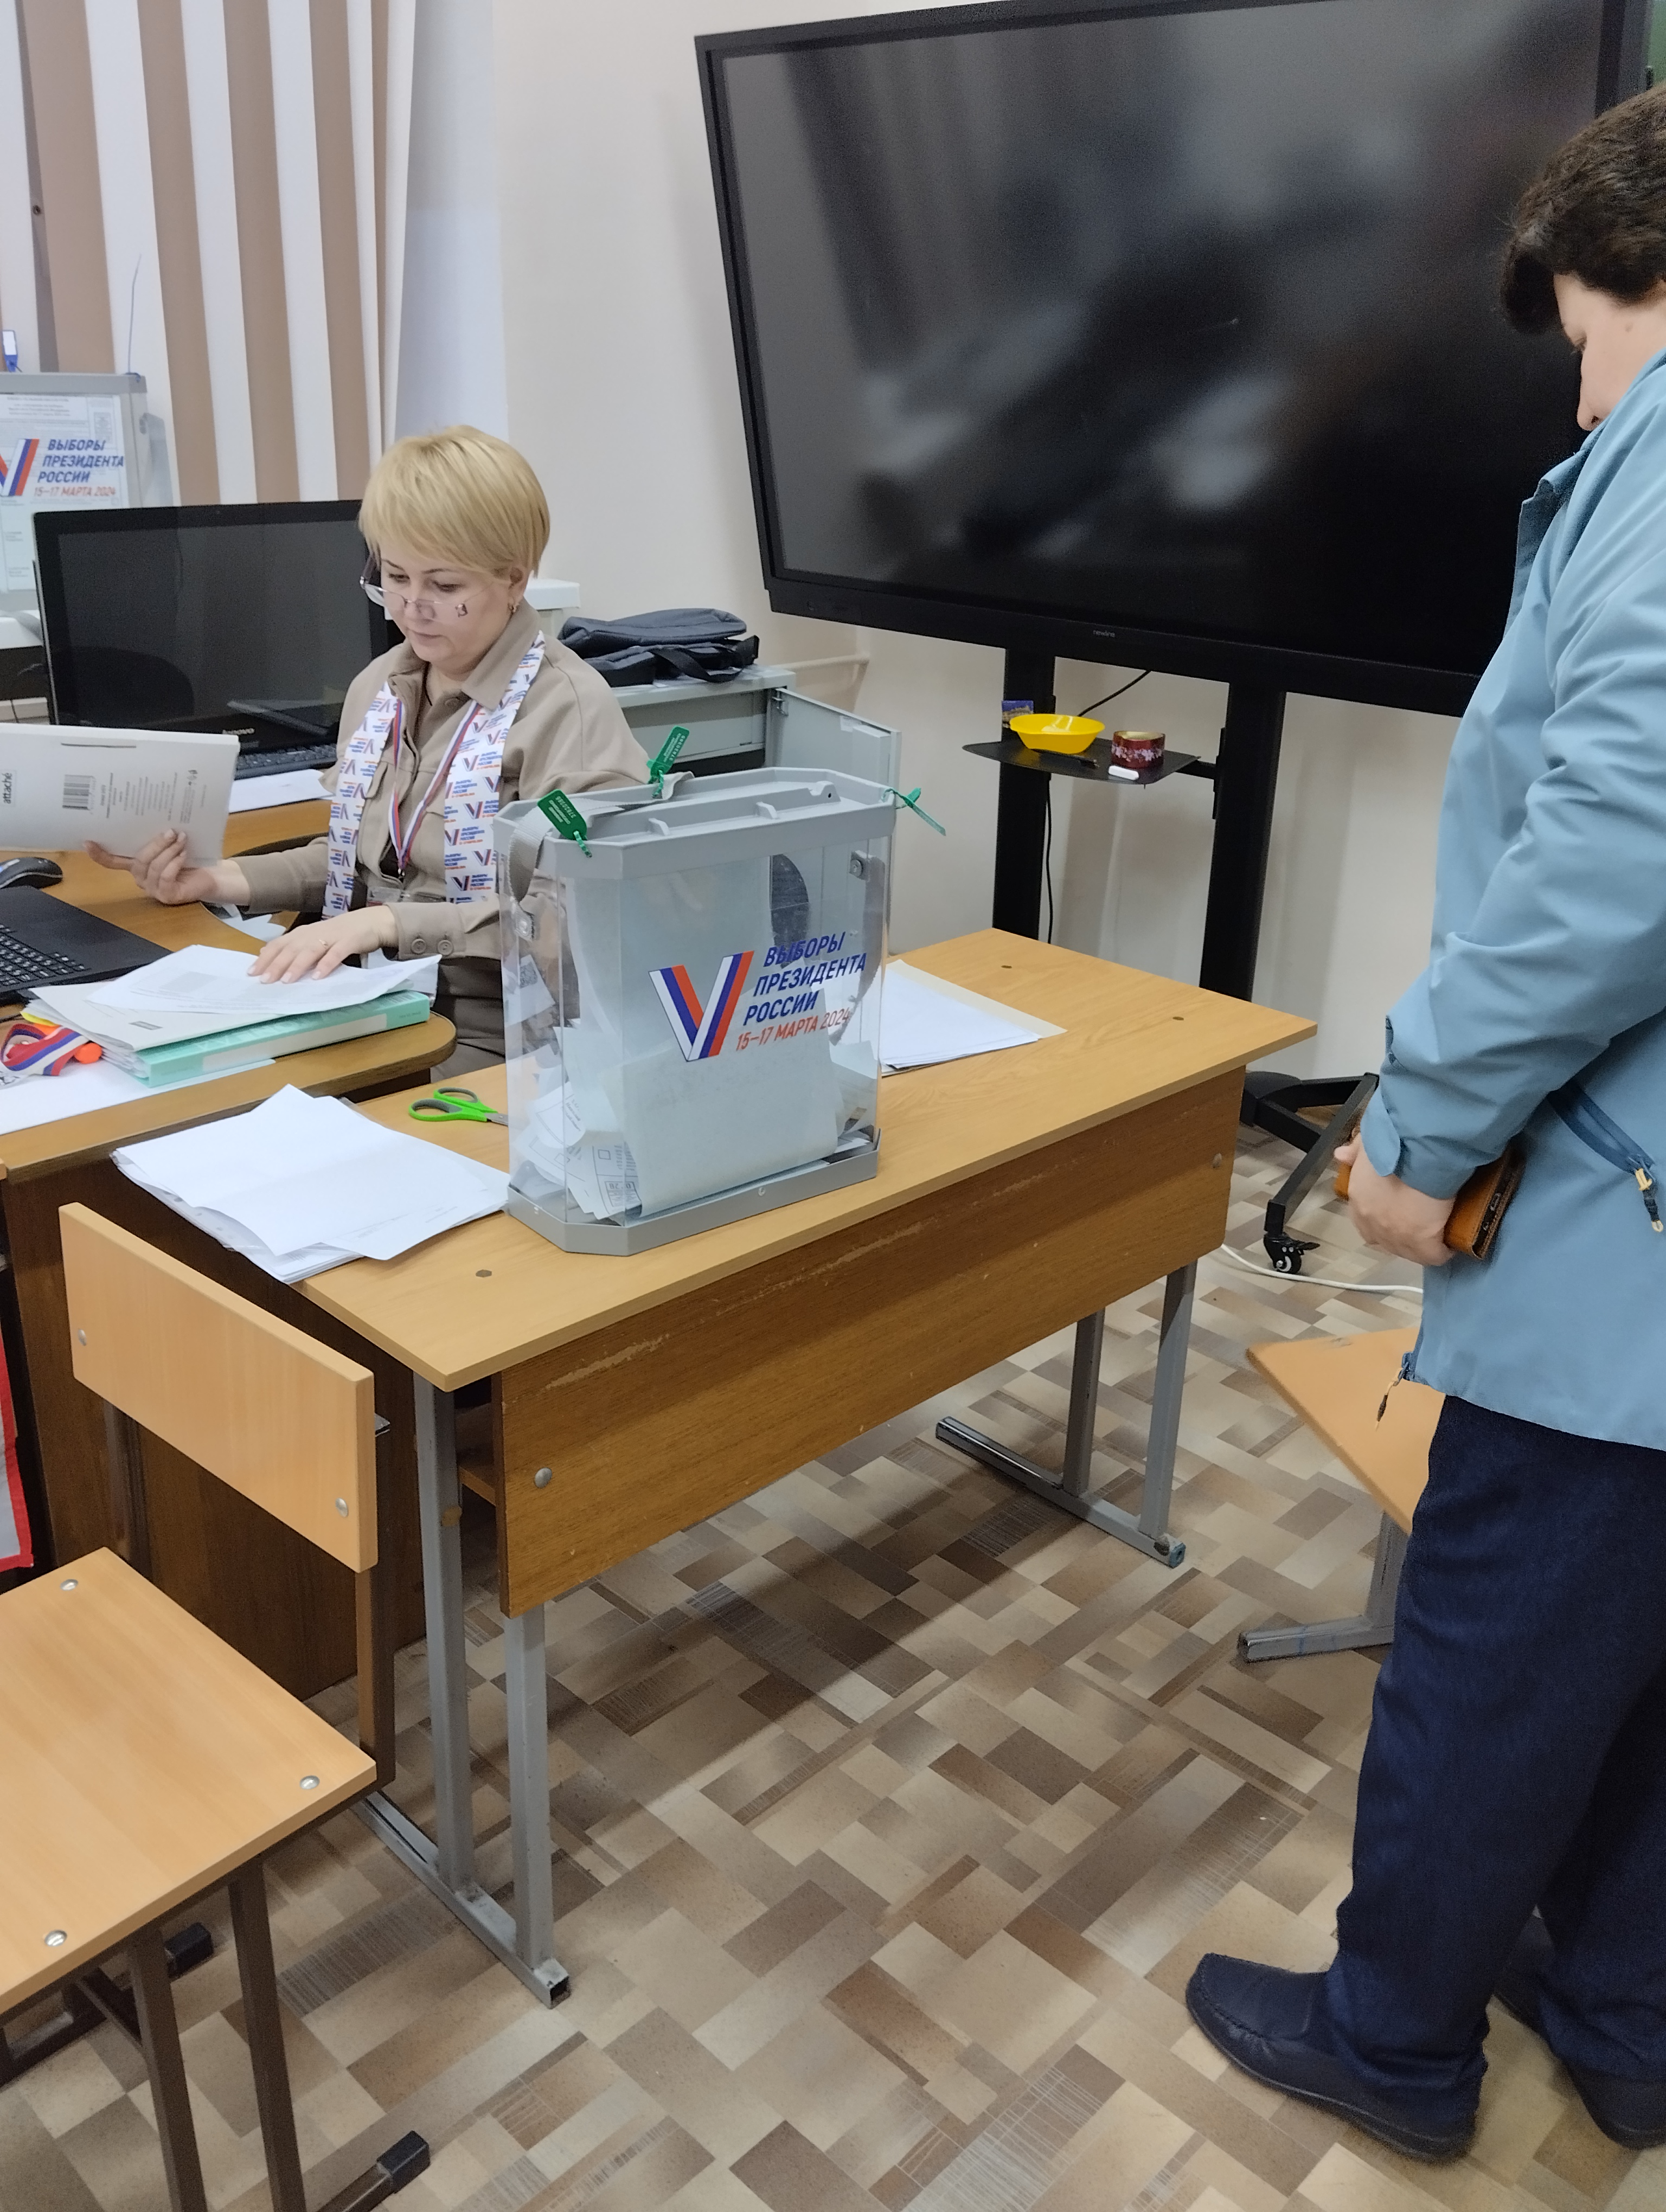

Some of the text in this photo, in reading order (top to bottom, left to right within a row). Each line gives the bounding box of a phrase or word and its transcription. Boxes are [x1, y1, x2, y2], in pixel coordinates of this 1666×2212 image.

[47, 439, 106, 451] ВЫБОРЫ
[42, 455, 124, 469] ПРЕЗИДЕНТА
[37, 471, 91, 484] РОССИИ
[60, 486, 92, 497] МАРТА
[762, 931, 846, 968] ВЫБОРЫ
[753, 952, 867, 997] ПРЕЗИДЕНТА
[742, 990, 820, 1026] РОССИИ
[773, 1015, 819, 1041] МАРТА
[819, 1007, 851, 1030] 2024
